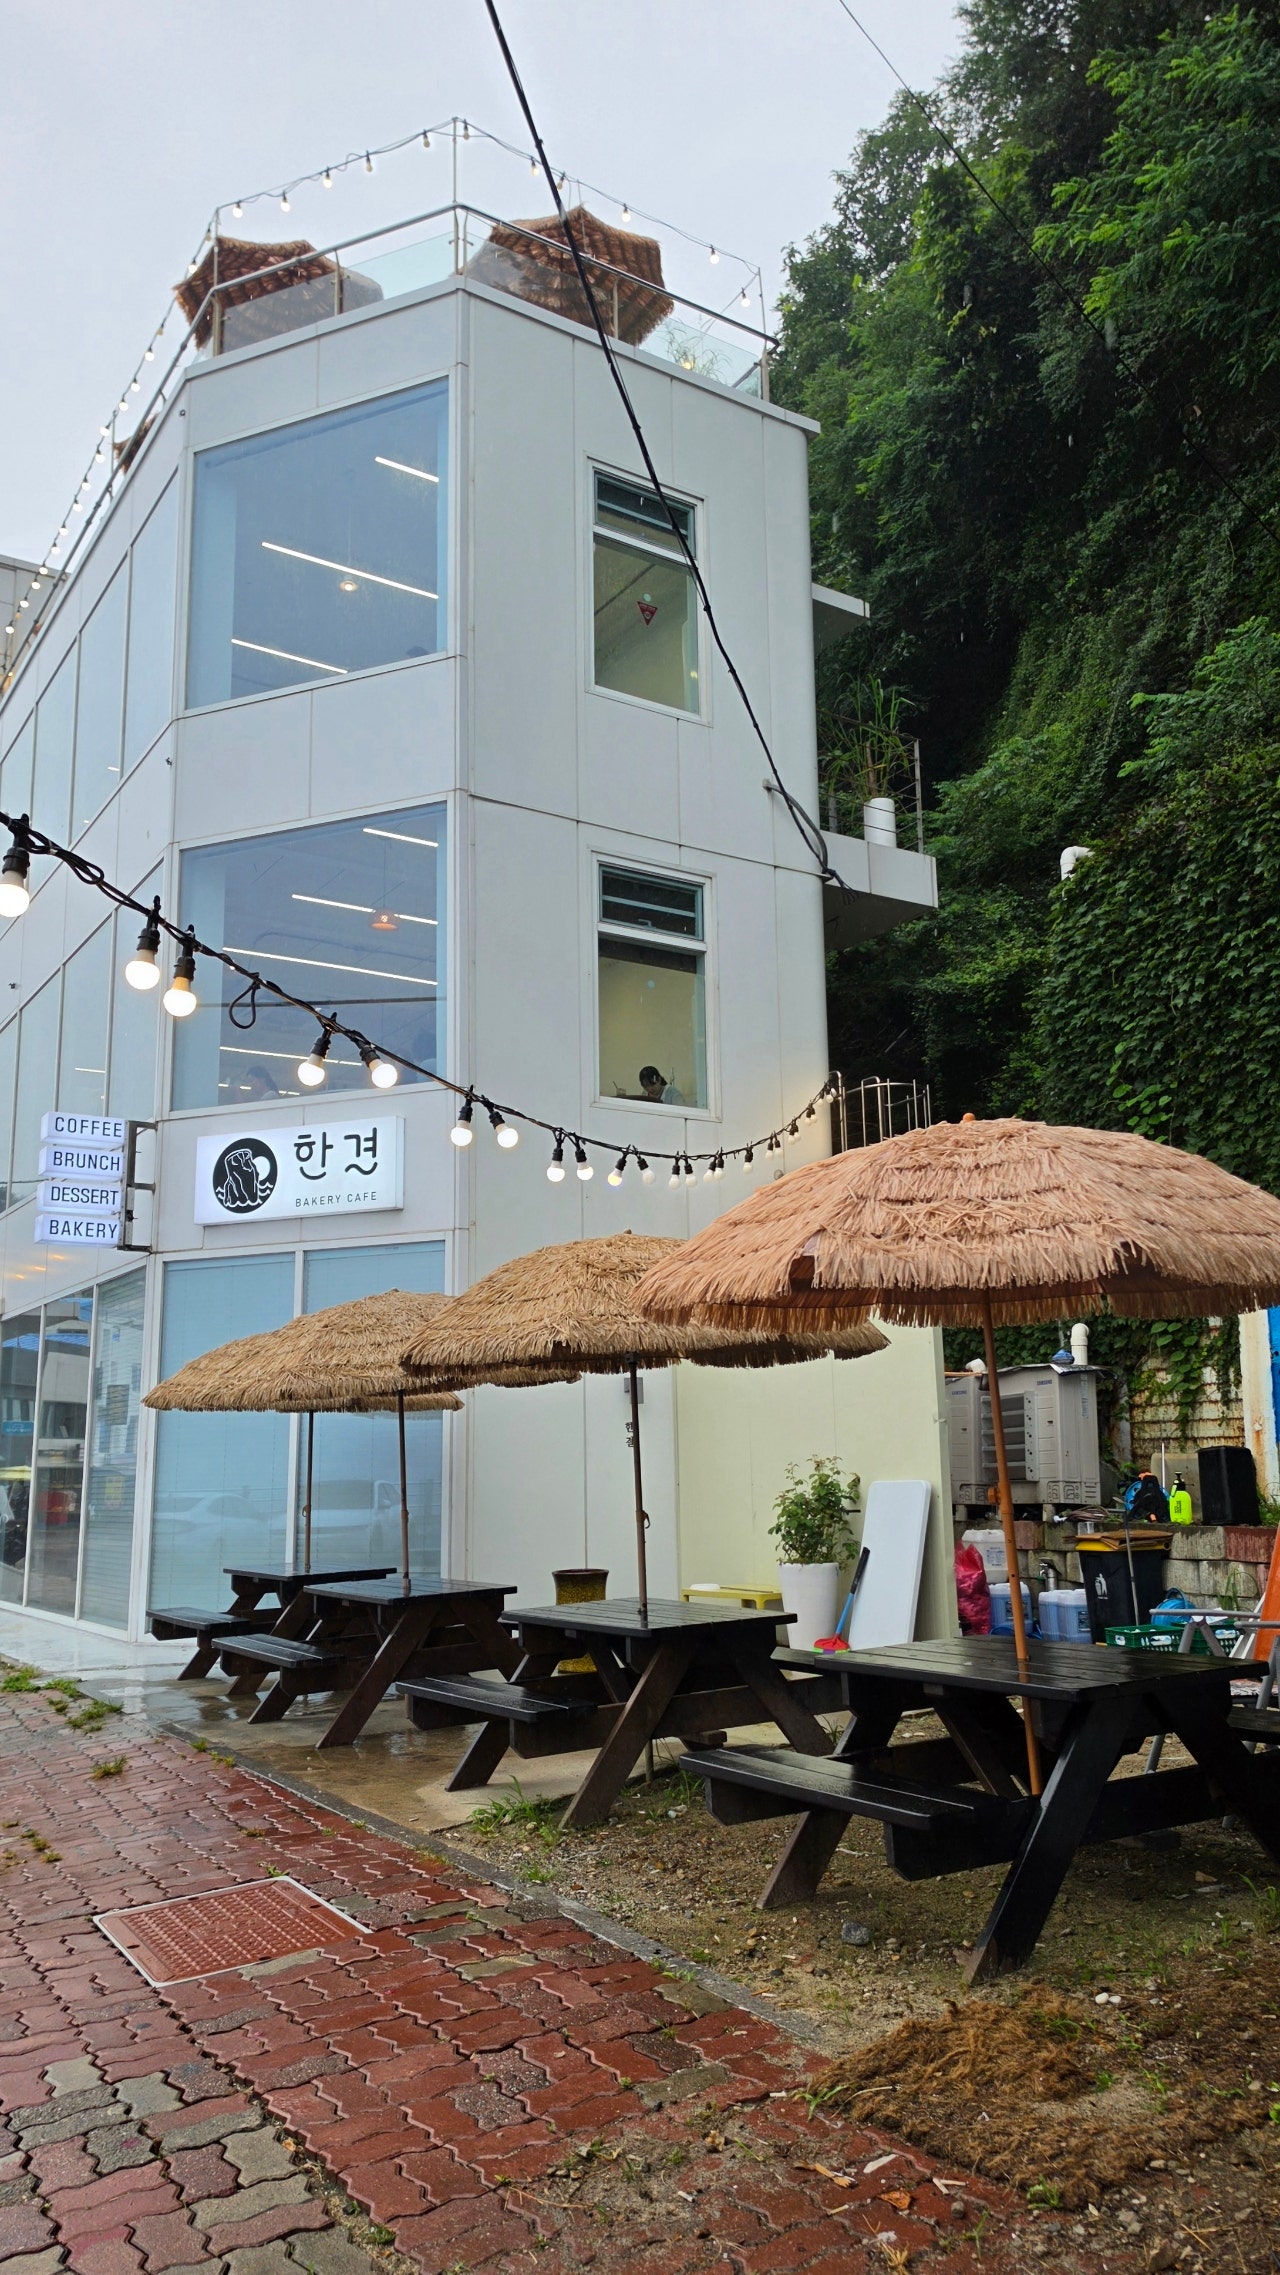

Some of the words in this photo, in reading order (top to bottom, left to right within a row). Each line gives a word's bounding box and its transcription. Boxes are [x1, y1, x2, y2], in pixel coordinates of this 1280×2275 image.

[55, 1116, 122, 1138] COFFEE
[53, 1151, 120, 1171] BRUNCH
[51, 1186, 119, 1206] DESSERT
[295, 1194, 341, 1208] BAKERY
[347, 1191, 377, 1203] CAFE
[49, 1219, 118, 1239] BAKERY
